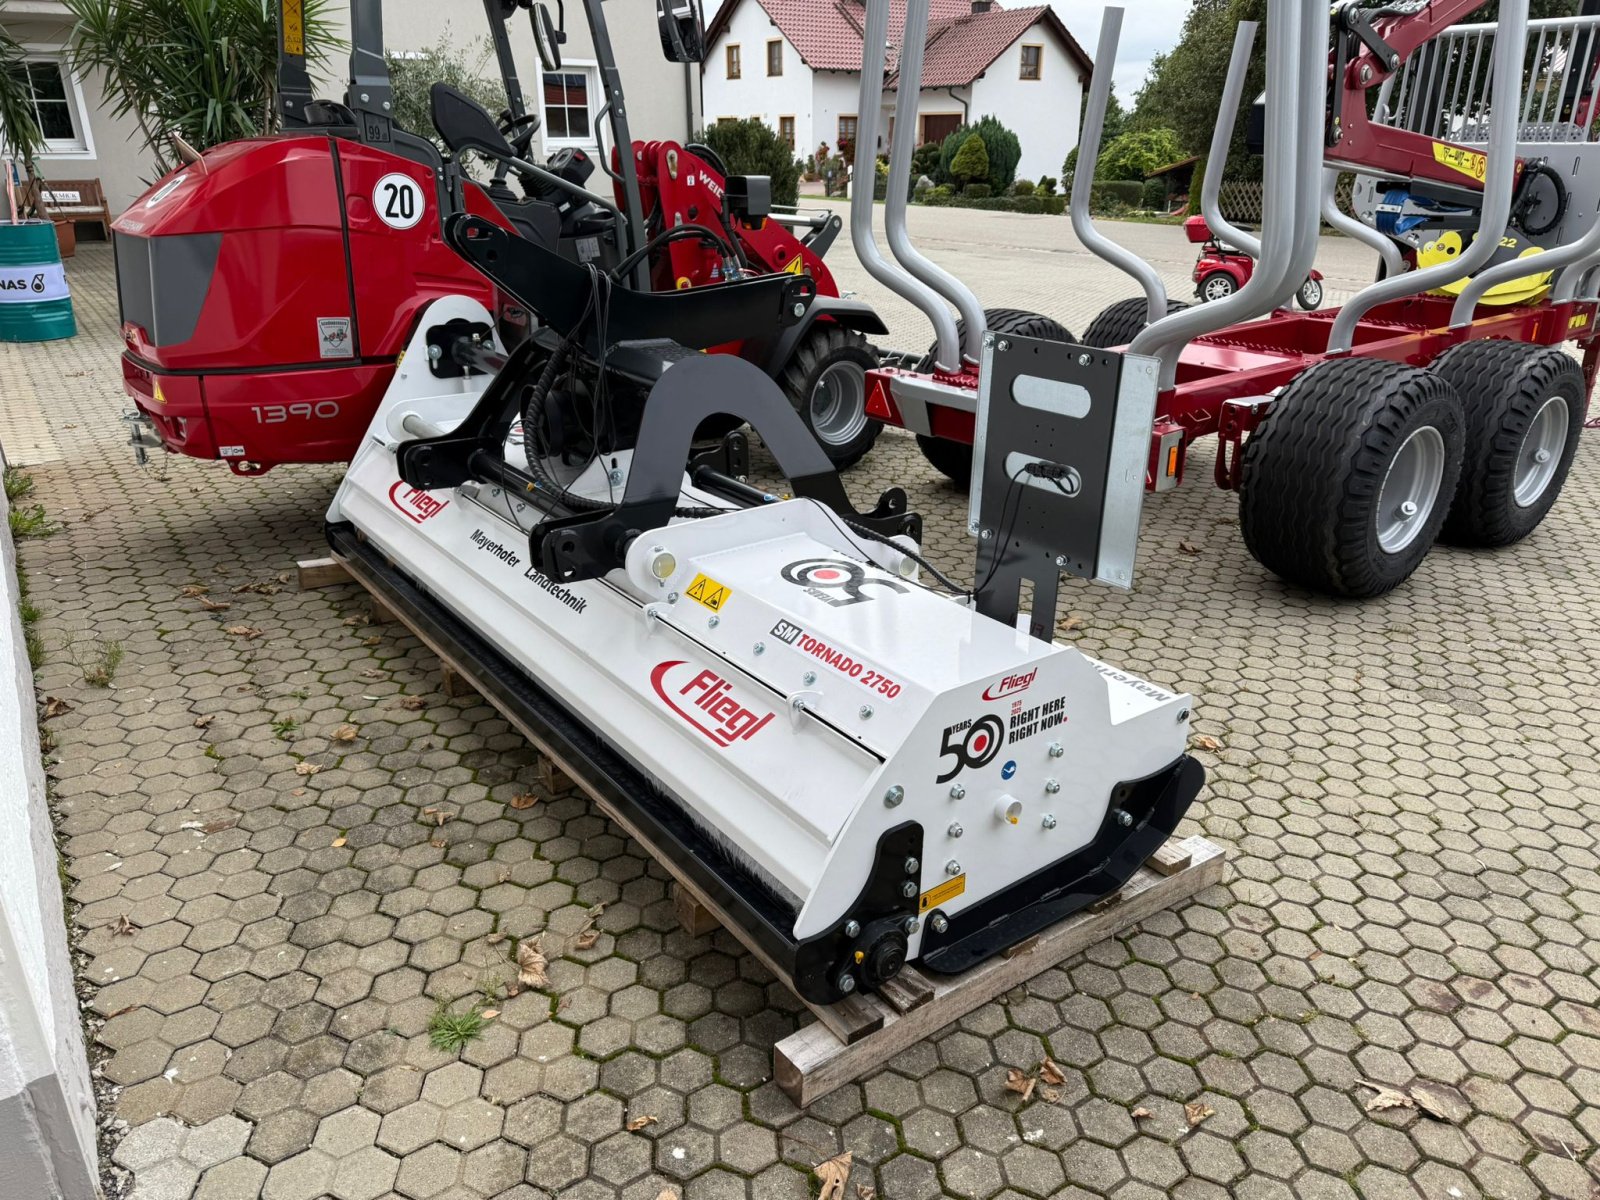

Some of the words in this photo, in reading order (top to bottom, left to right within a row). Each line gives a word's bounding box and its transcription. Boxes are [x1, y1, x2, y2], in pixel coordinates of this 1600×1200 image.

[369, 126, 380, 140] 99
[384, 183, 414, 219] 20
[251, 401, 339, 424] 1390
[470, 529, 520, 568] Mayerhofer
[523, 566, 588, 614] Landtechnik
[773, 622, 798, 644] SM
[796, 633, 863, 677] TORNADO
[860, 671, 901, 699] 2750
[999, 667, 1038, 693] Fliegl
[679, 669, 776, 742] Fliegl
[1010, 706, 1040, 729] RIGHT
[1042, 696, 1066, 717] HERE
[951, 719, 972, 735] YEARS
[1008, 724, 1038, 744] RIGHT
[1040, 711, 1068, 731] NOW.
[936, 714, 1004, 784] 50
